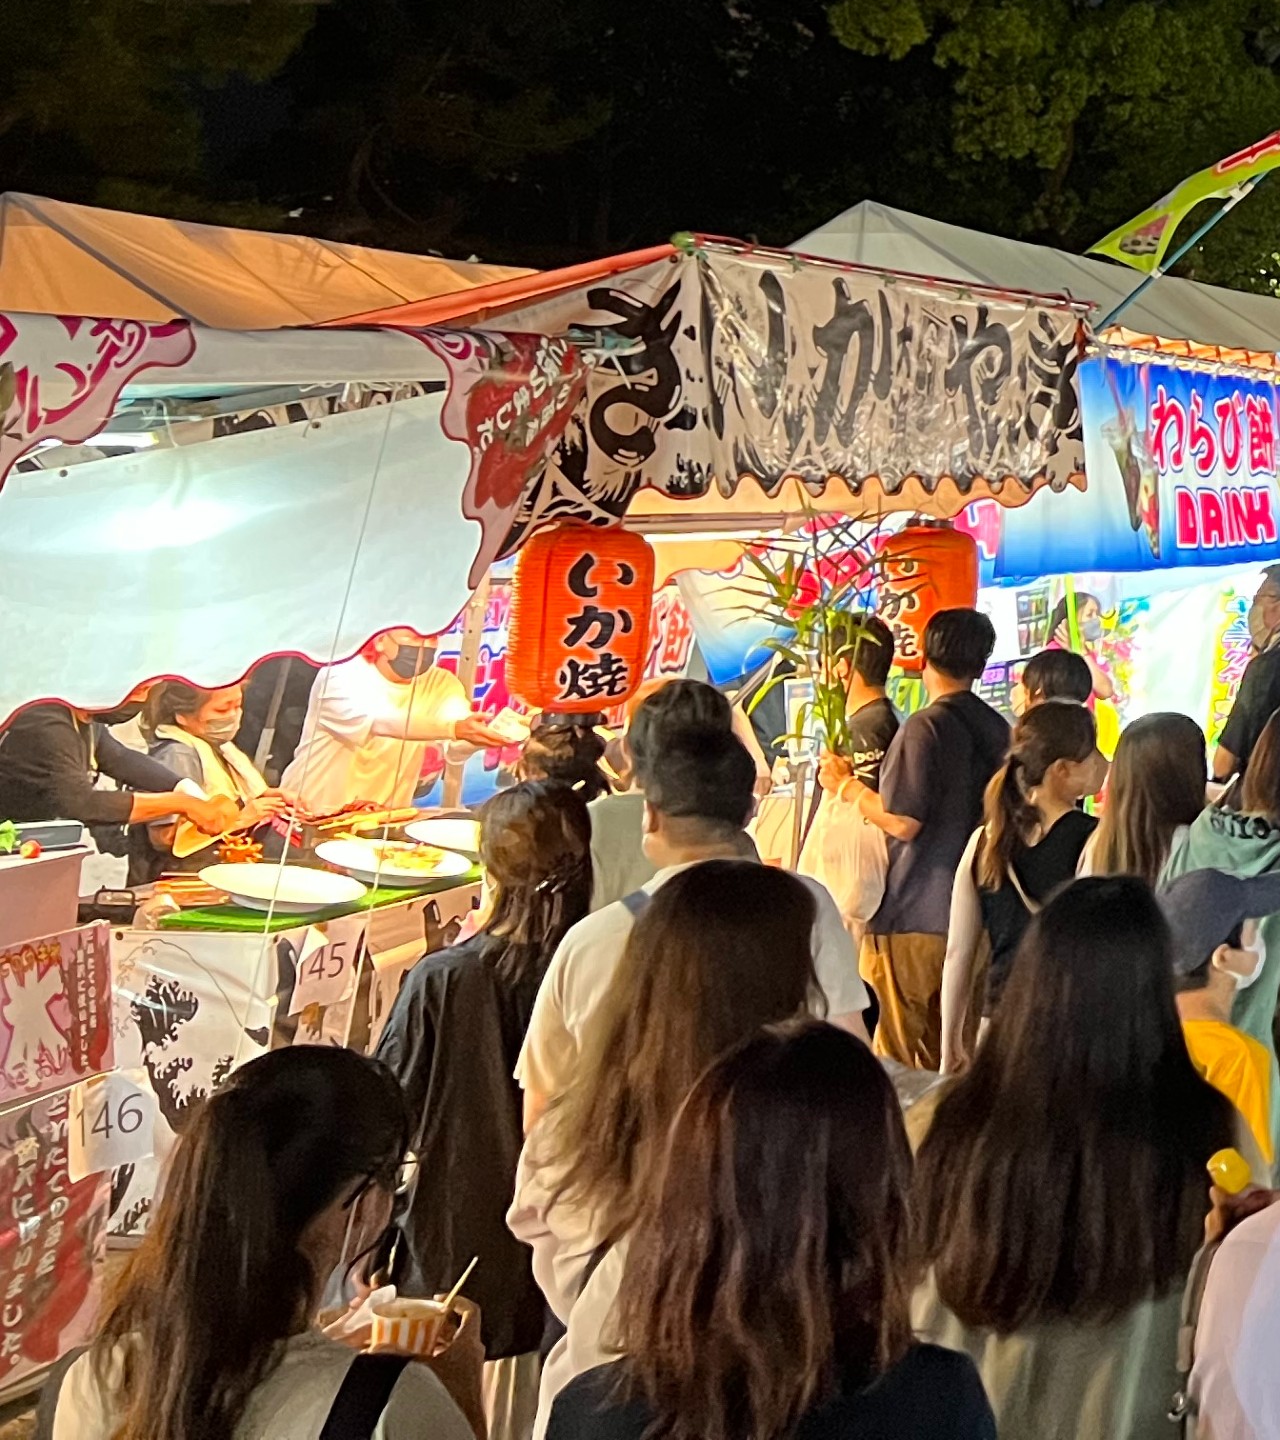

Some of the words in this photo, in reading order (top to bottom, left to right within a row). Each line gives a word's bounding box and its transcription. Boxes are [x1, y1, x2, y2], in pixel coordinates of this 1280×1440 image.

[1151, 386, 1276, 473] わらび餅
[1176, 488, 1277, 547] DRINK
[559, 553, 634, 700] いか焼
[75, 1092, 143, 1147] 146
